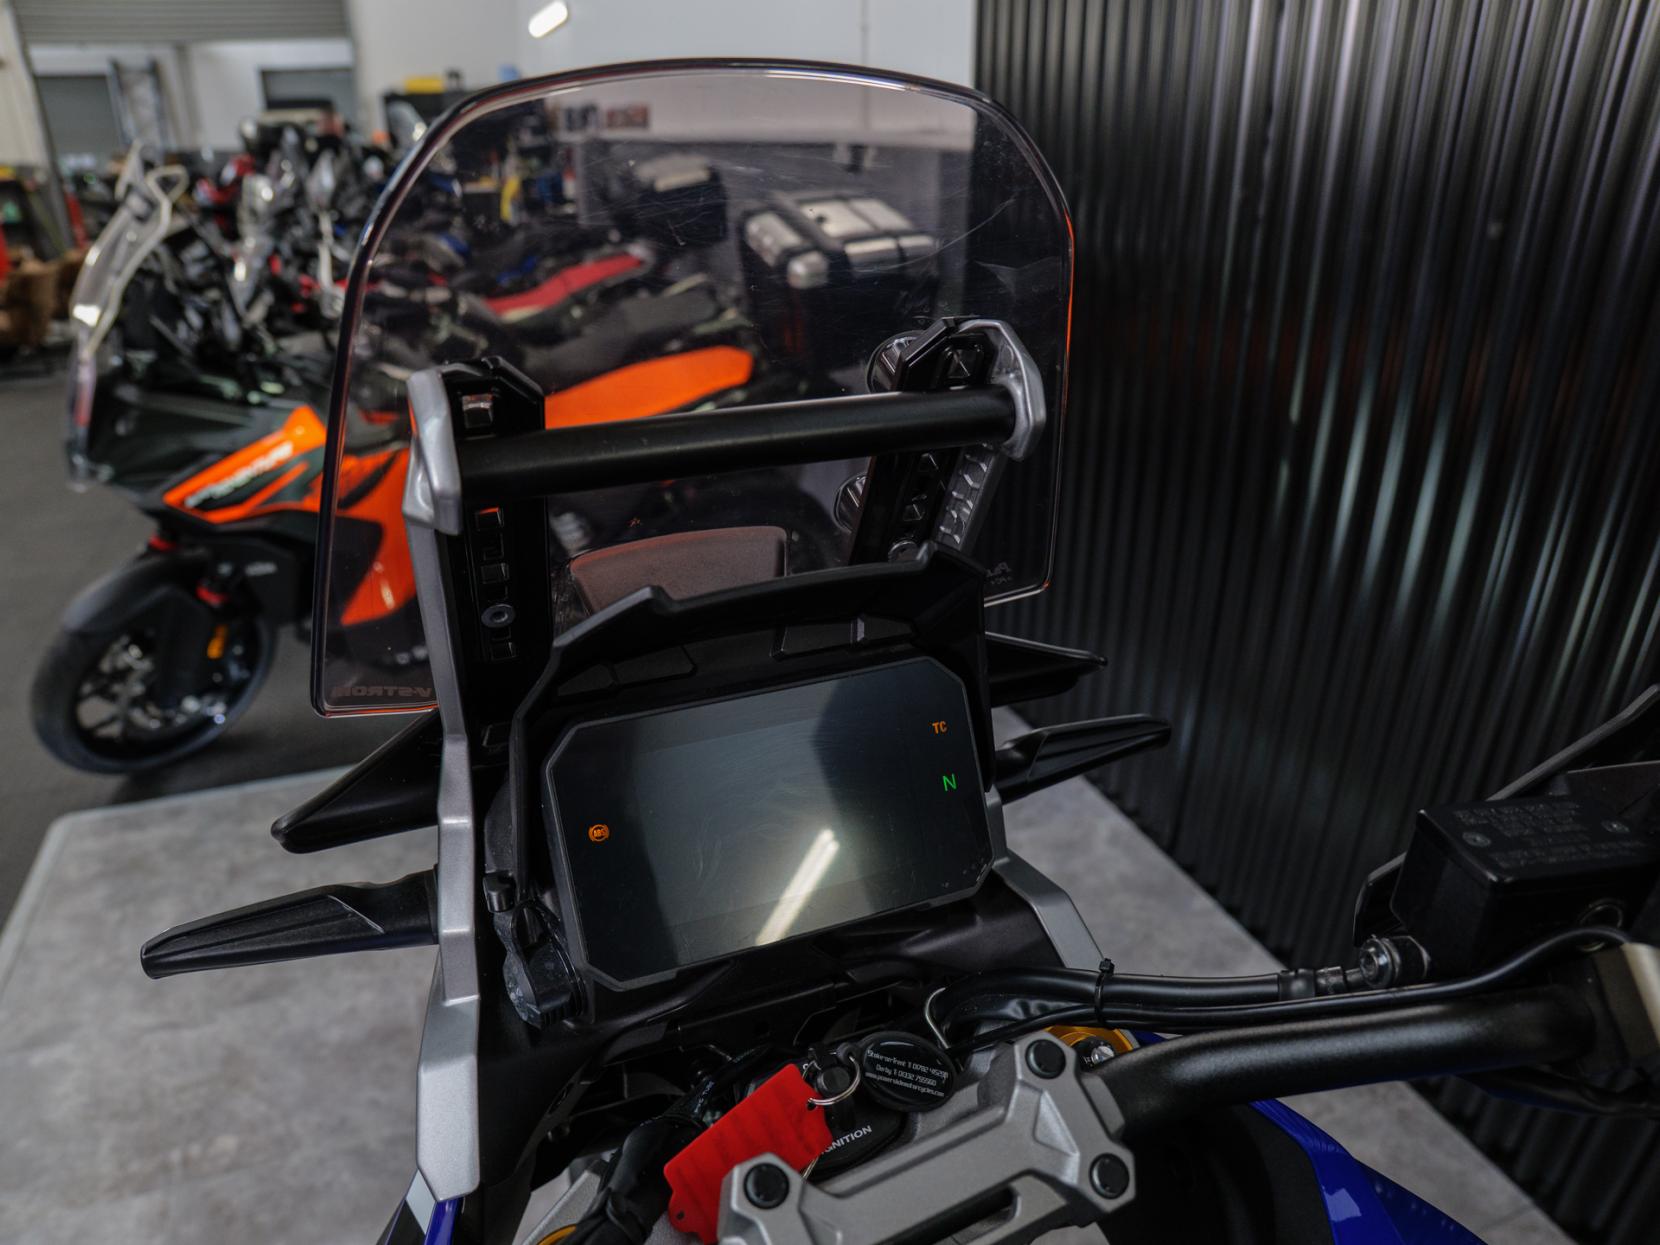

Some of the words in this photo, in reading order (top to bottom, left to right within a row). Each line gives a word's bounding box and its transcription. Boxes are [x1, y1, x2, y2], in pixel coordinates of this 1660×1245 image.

[932, 720, 948, 735] TC
[943, 773, 957, 792] N
[821, 1125, 873, 1155] NITION
